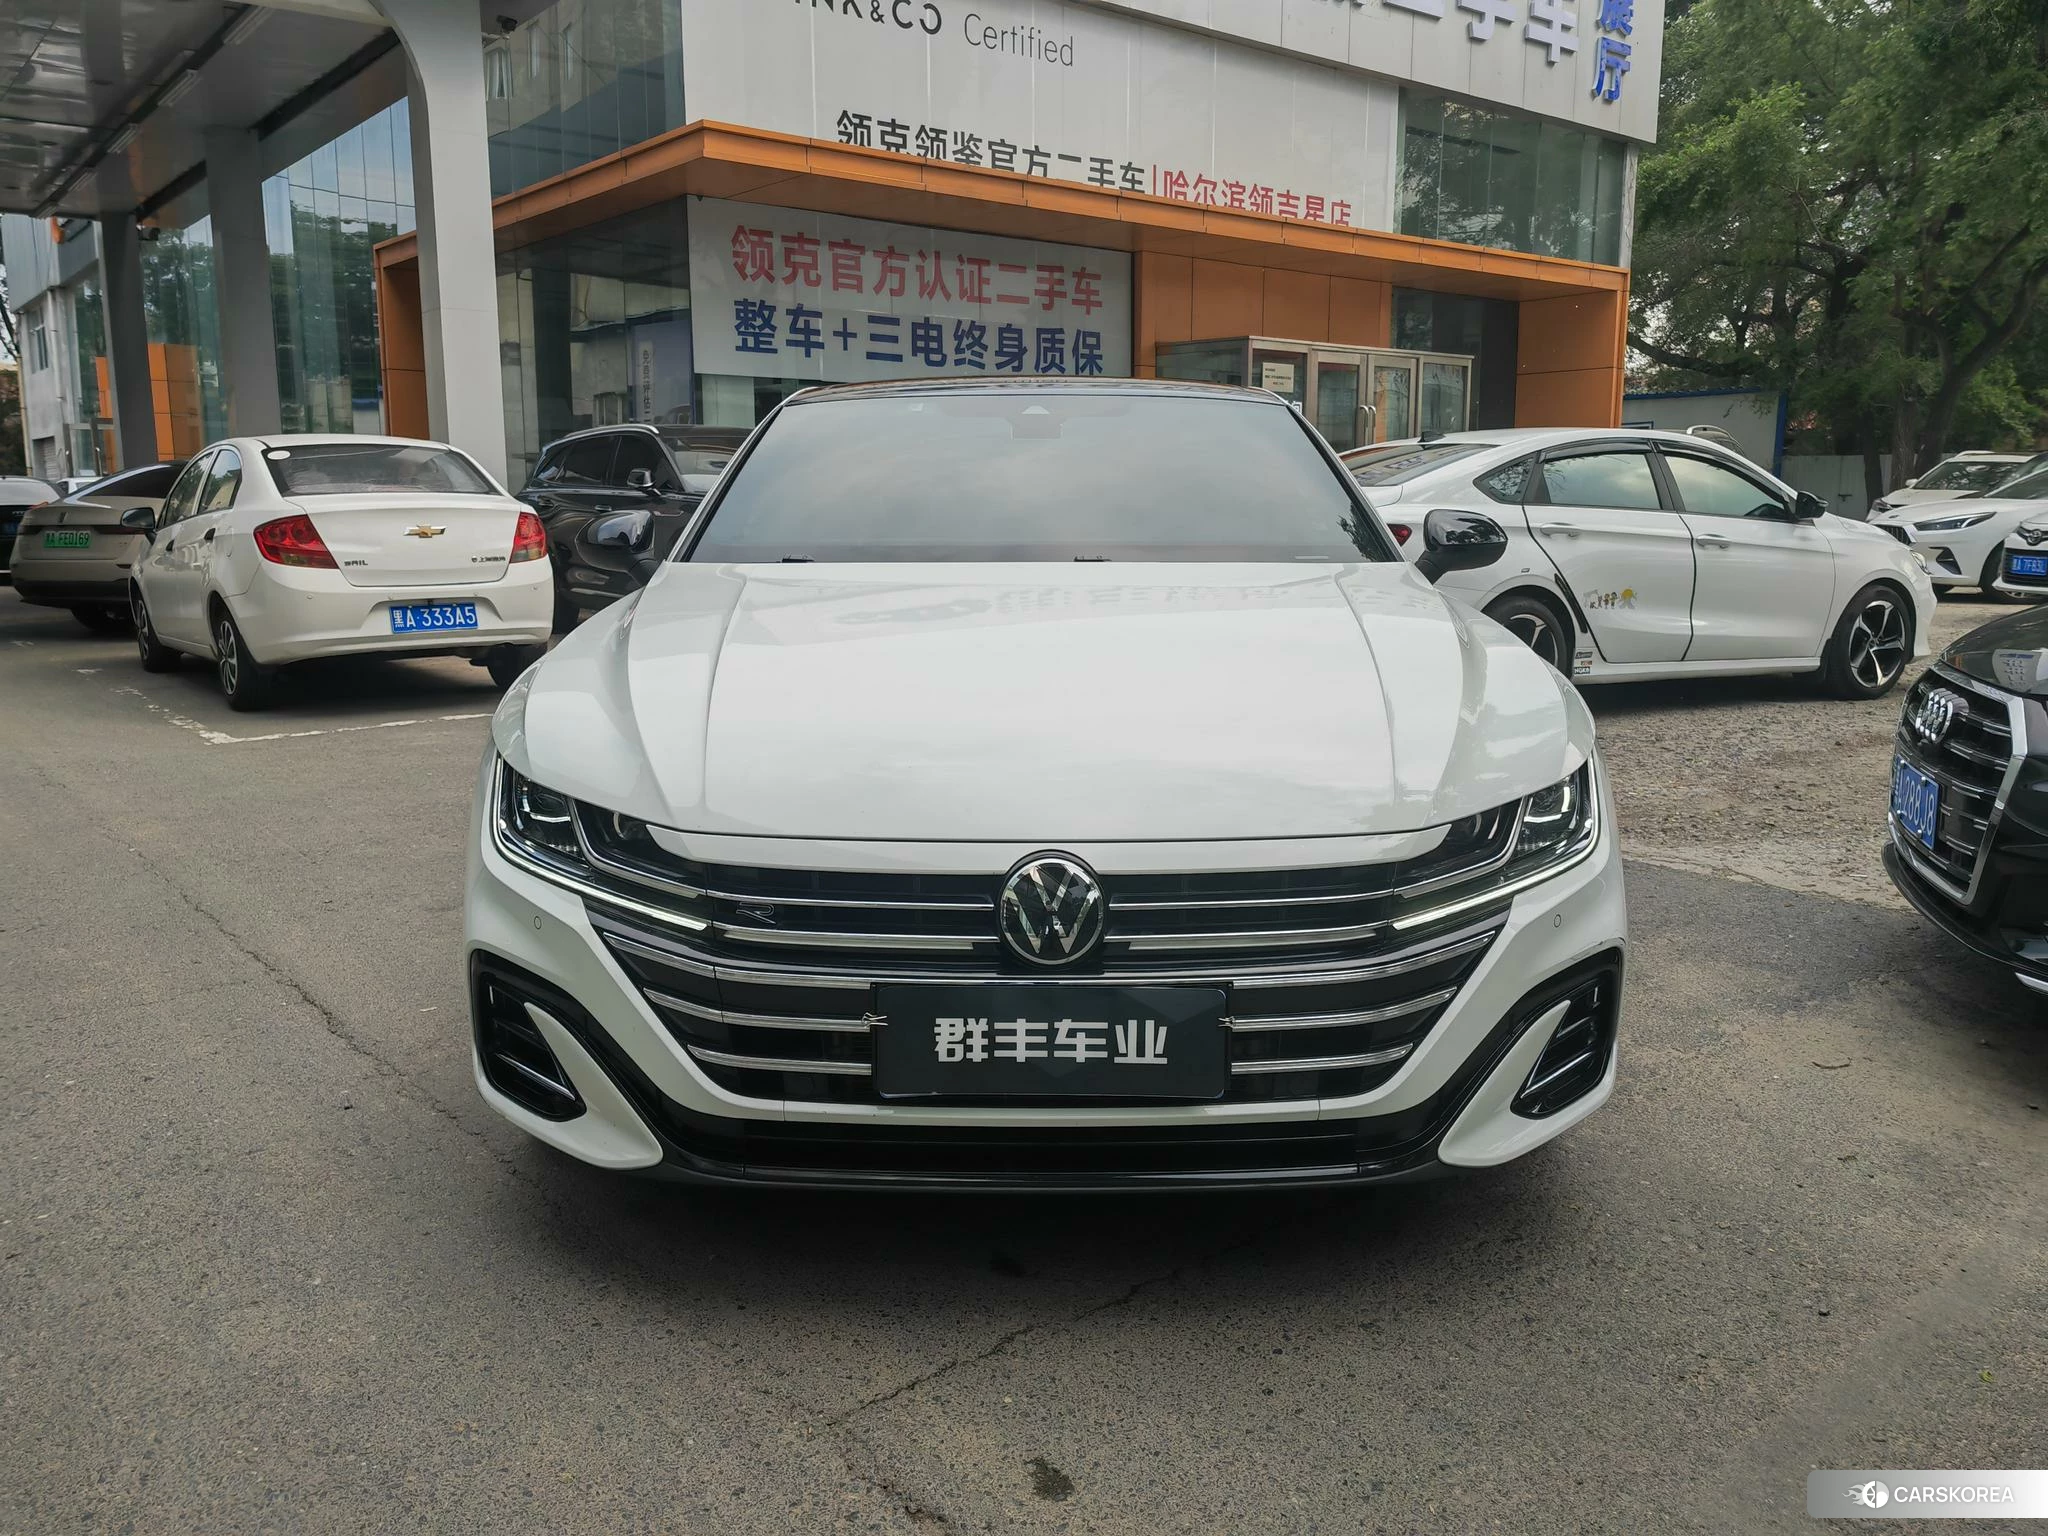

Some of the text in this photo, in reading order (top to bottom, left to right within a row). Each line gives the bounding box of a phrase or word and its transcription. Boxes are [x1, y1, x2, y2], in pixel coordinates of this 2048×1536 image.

[964, 14, 1073, 66] Certified
[731, 225, 1103, 316] 领克官方认证二手车
[734, 298, 1103, 376] 整车+三电终身质保
[934, 1018, 1168, 1064] 群丰车业
